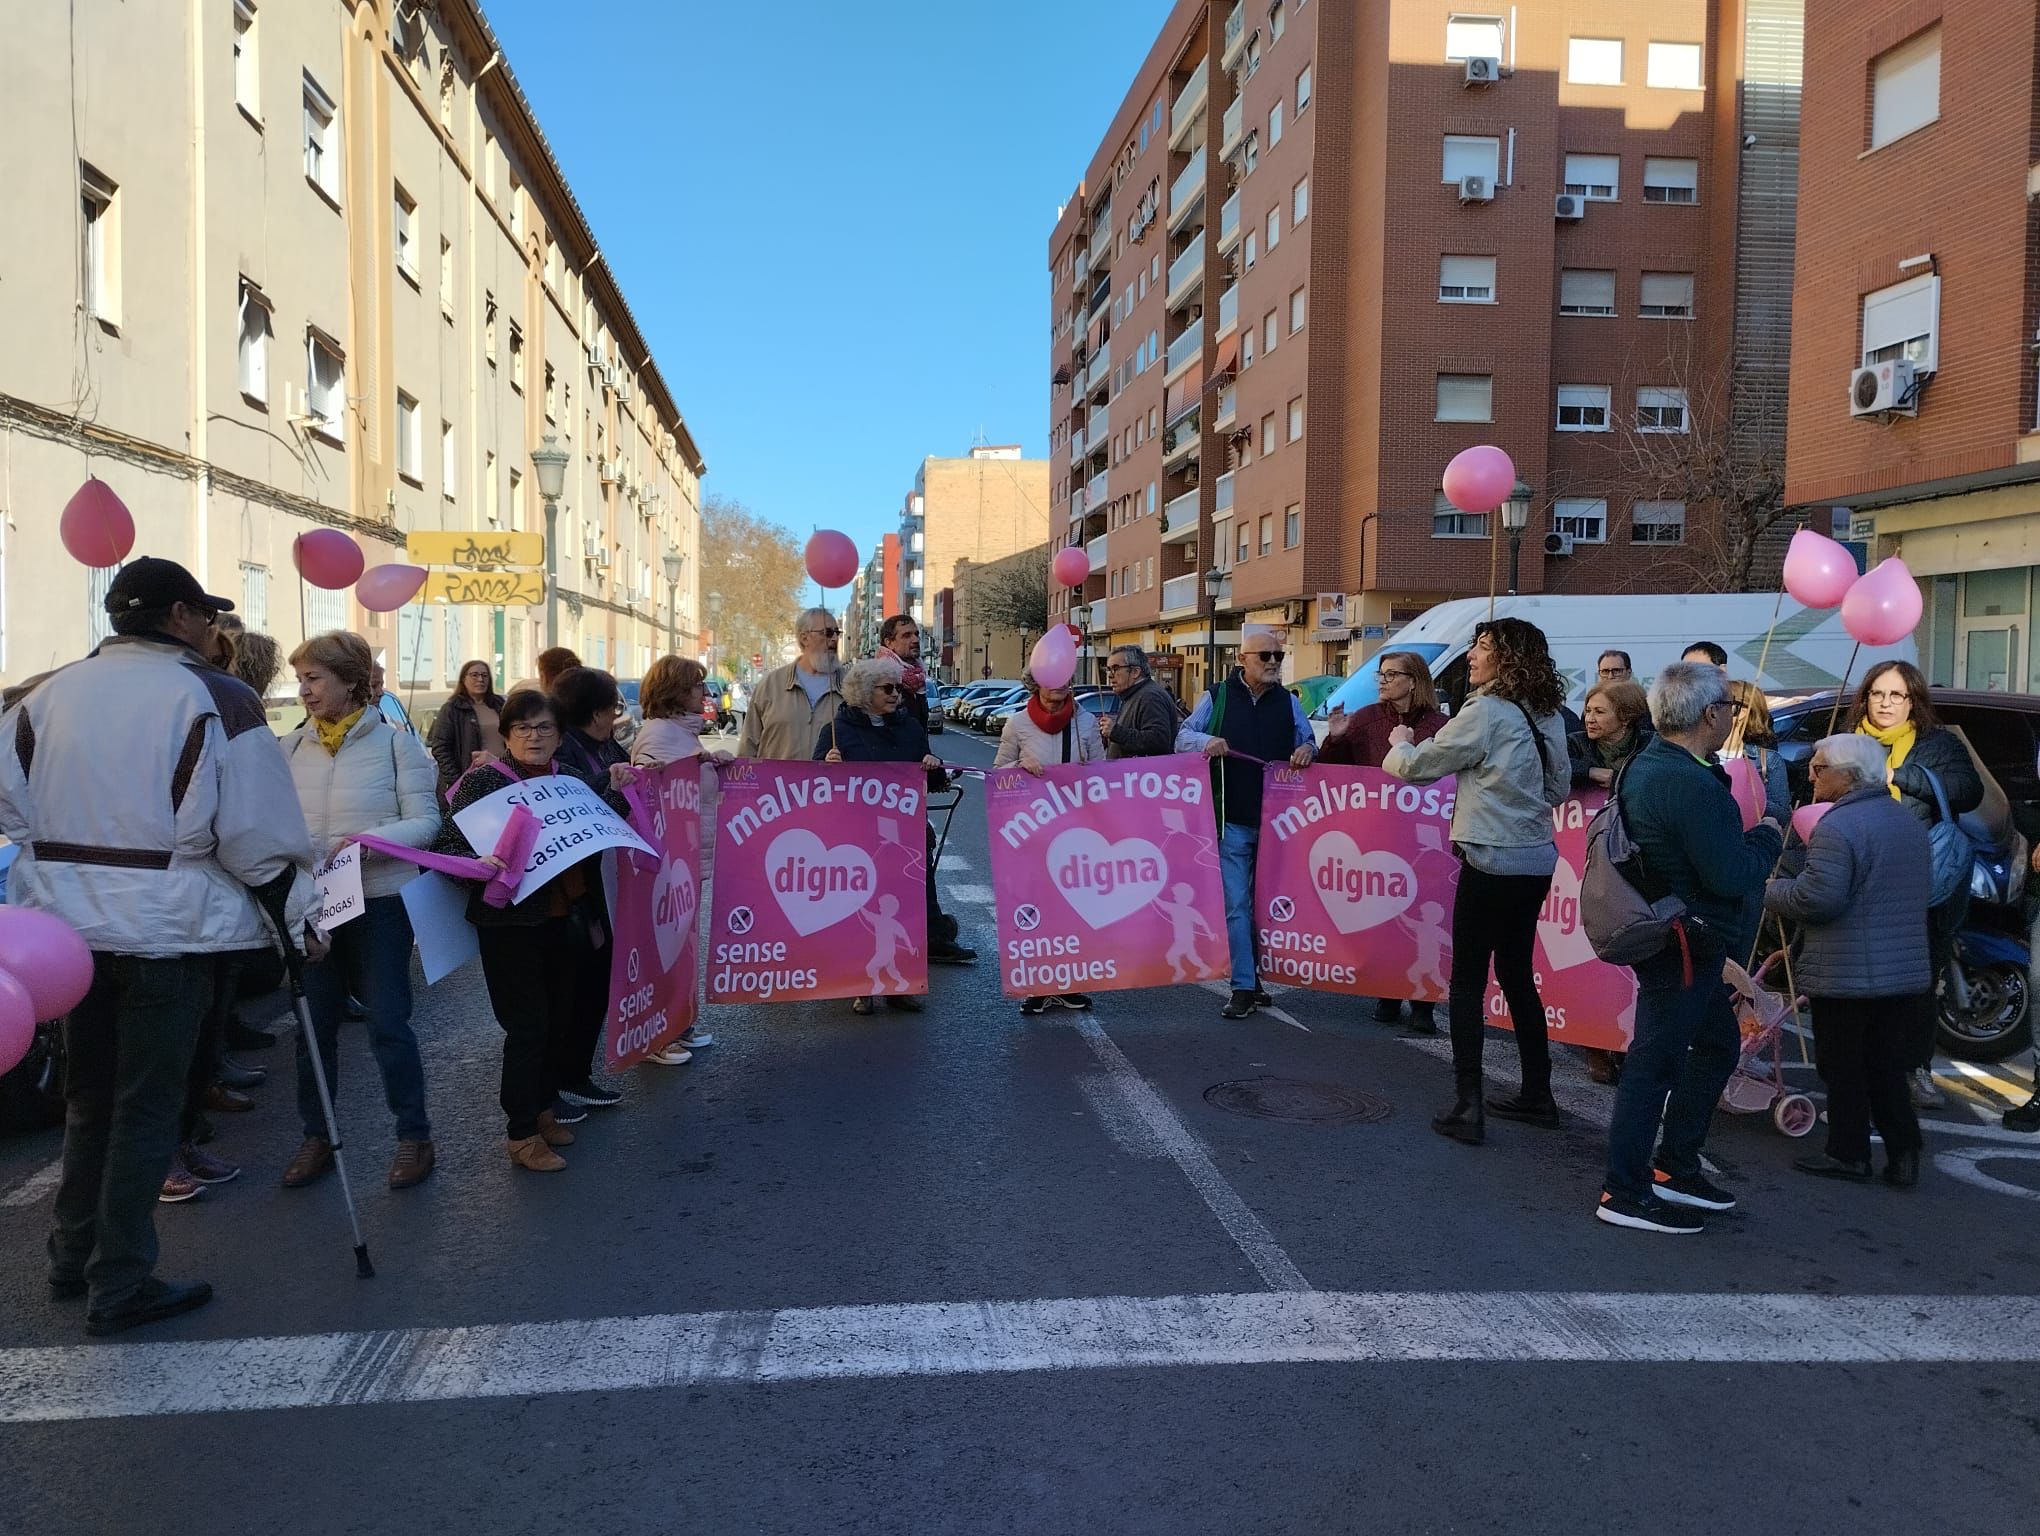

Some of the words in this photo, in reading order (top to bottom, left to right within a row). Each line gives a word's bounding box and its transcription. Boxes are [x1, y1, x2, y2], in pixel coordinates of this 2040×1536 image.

[533, 784, 552, 802] al
[726, 775, 919, 846] malva-rosa
[999, 771, 1203, 849] malva-rosa
[1270, 780, 1457, 842] malva-rosa
[775, 856, 869, 901] digna
[1059, 854, 1160, 895] digna
[1317, 857, 1409, 902] digna
[716, 941, 787, 964] sense
[1008, 934, 1081, 960] sense
[1260, 927, 1327, 954] sense
[714, 965, 818, 998] drogues
[1010, 959, 1118, 990] drogues
[1260, 949, 1357, 984] drogues
[618, 983, 655, 1022] sense
[616, 1008, 668, 1057] drogues
